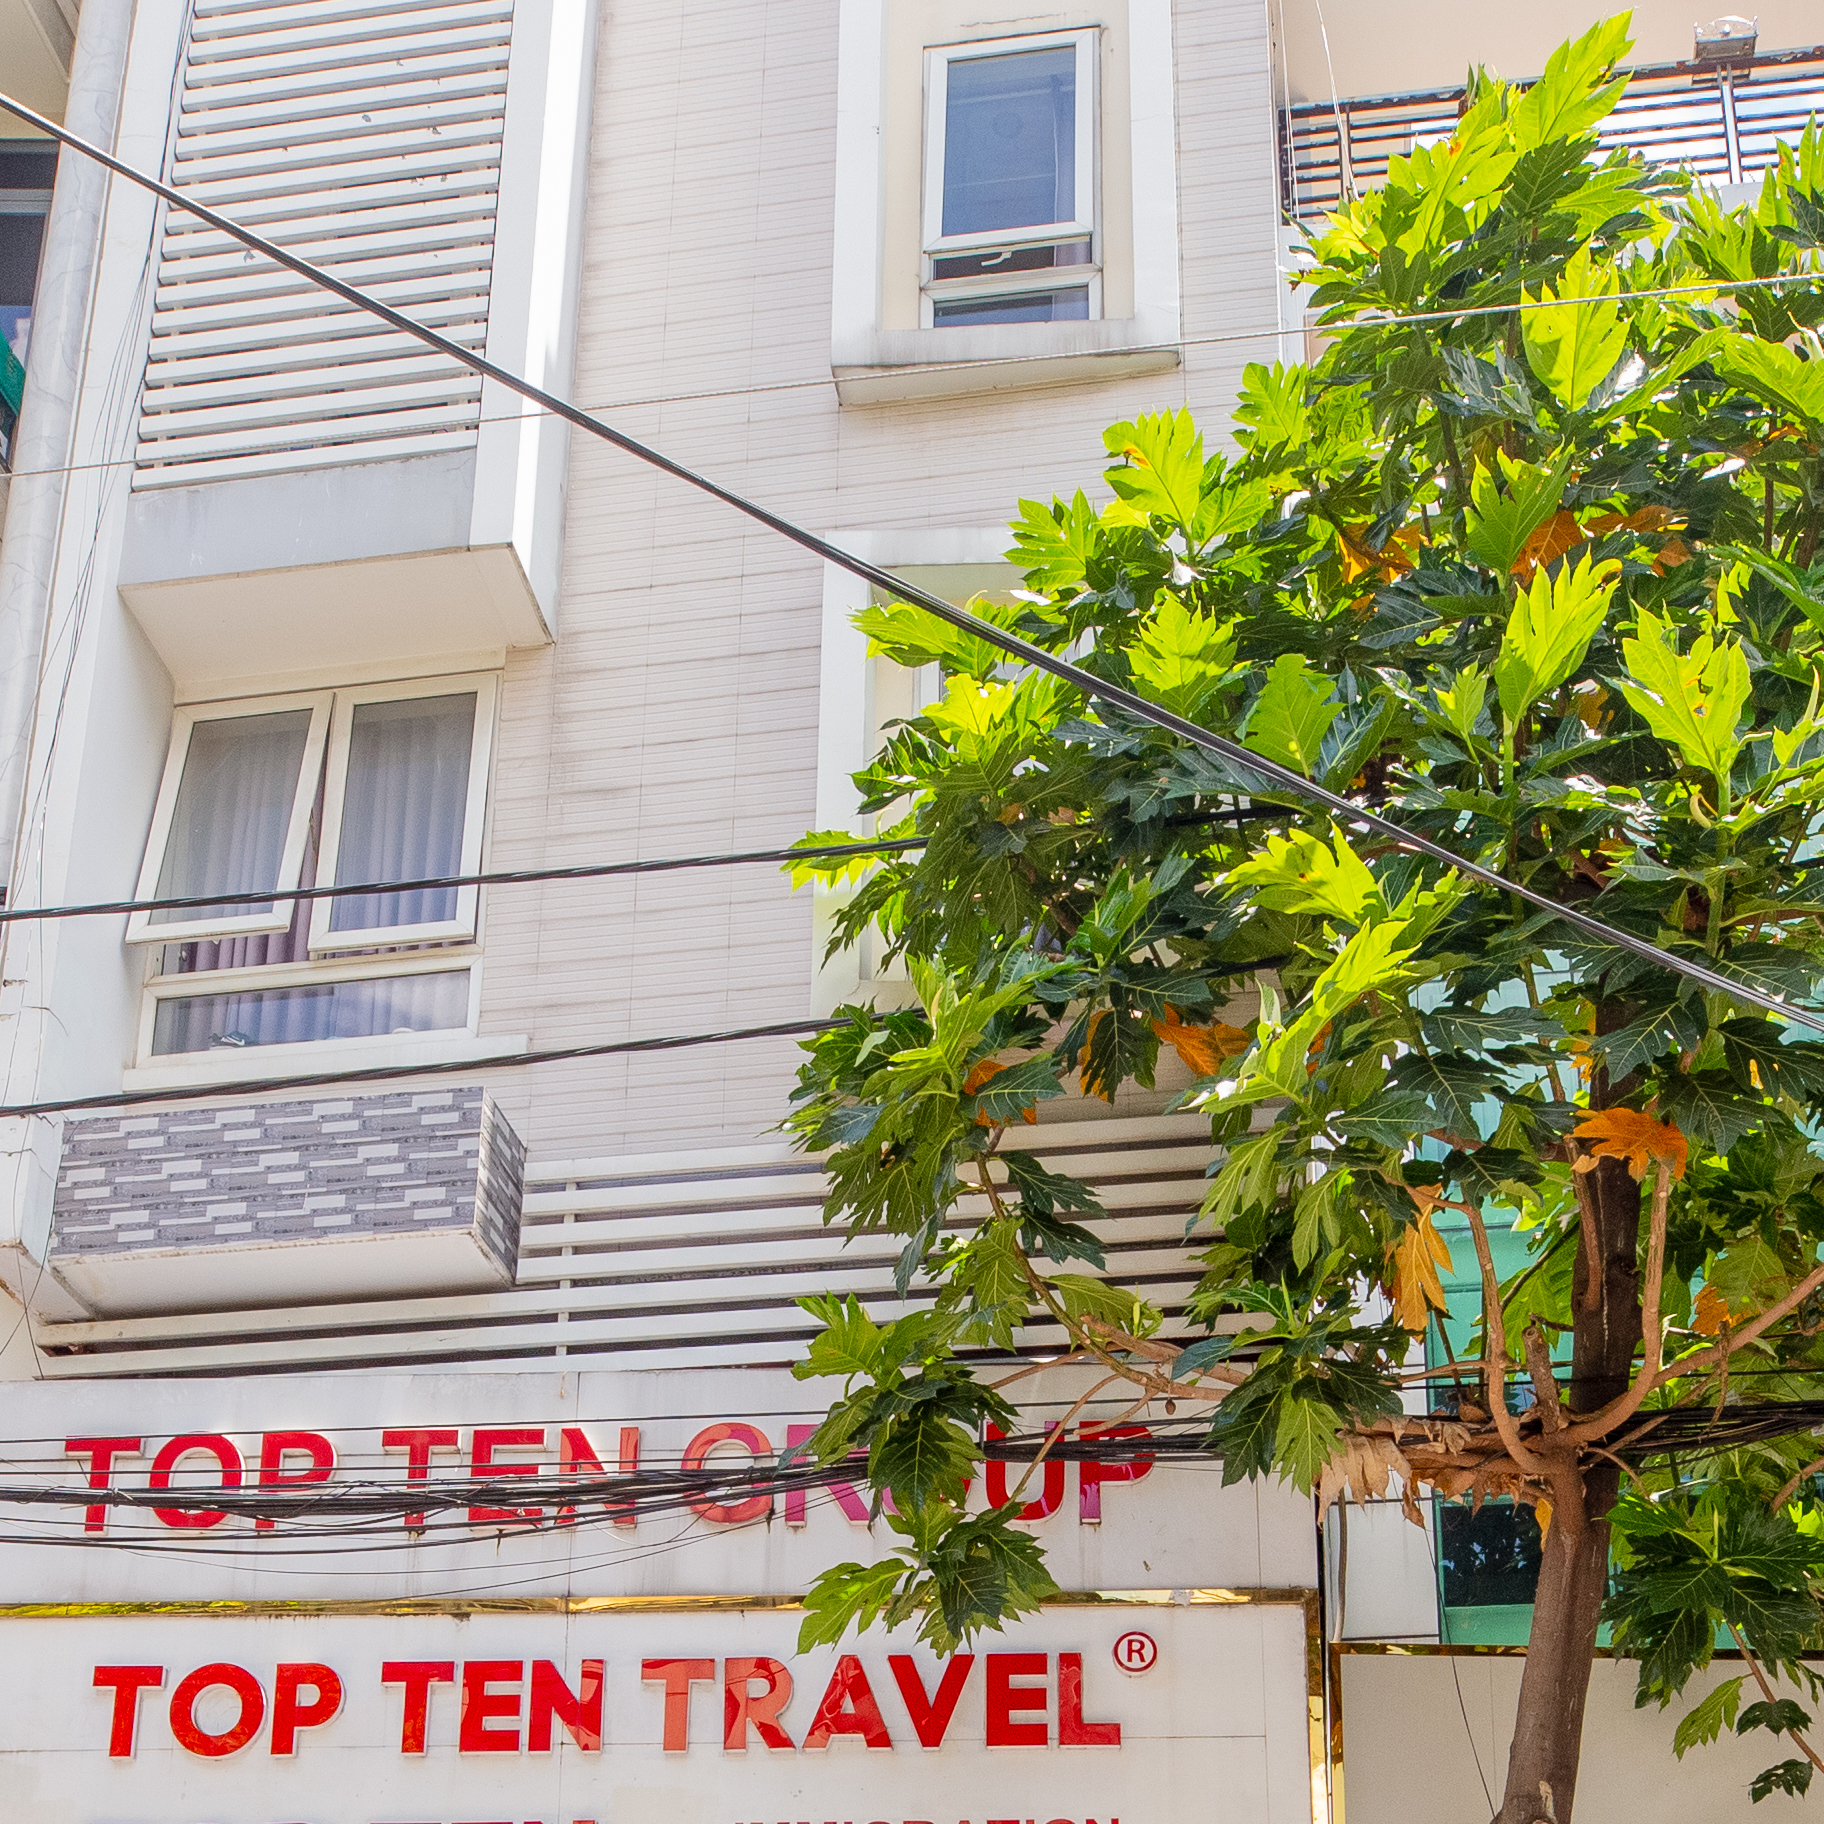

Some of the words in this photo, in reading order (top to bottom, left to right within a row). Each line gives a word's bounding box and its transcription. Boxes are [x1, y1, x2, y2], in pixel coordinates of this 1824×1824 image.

[64, 1430, 338, 1533] TOP
[381, 1425, 641, 1531] TEN
[91, 1661, 344, 1760] TOP
[381, 1658, 605, 1756] TEN
